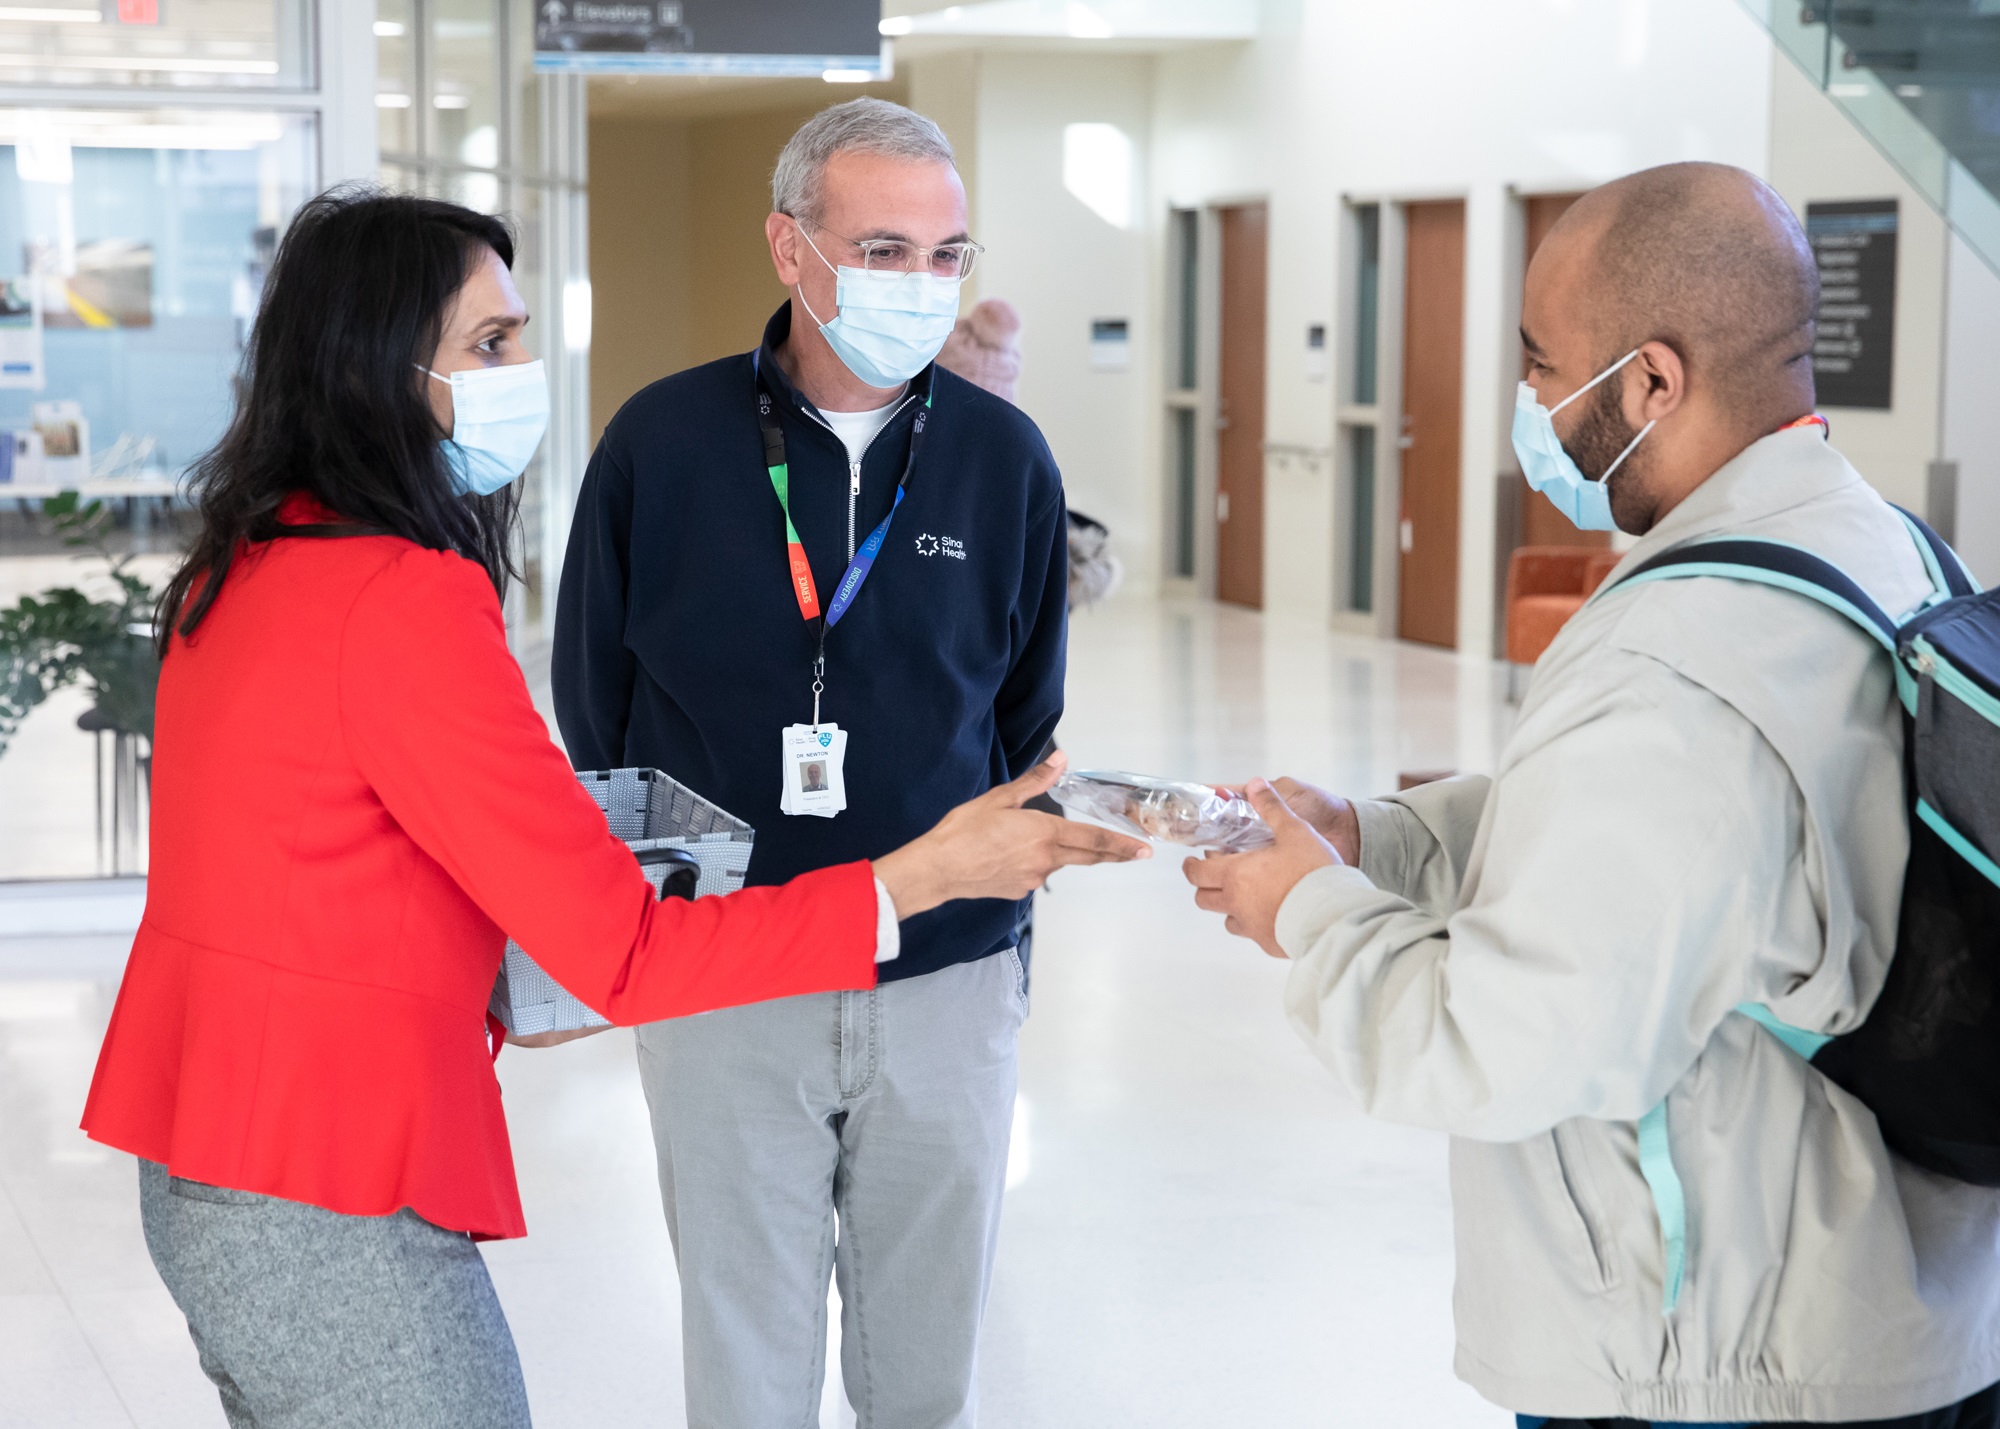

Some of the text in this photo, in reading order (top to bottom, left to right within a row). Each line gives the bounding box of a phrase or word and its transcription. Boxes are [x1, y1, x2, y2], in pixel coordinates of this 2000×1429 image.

[941, 536, 964, 549] Sinai
[798, 575, 812, 604] SERVICE
[840, 566, 862, 603] DISCOVERY
